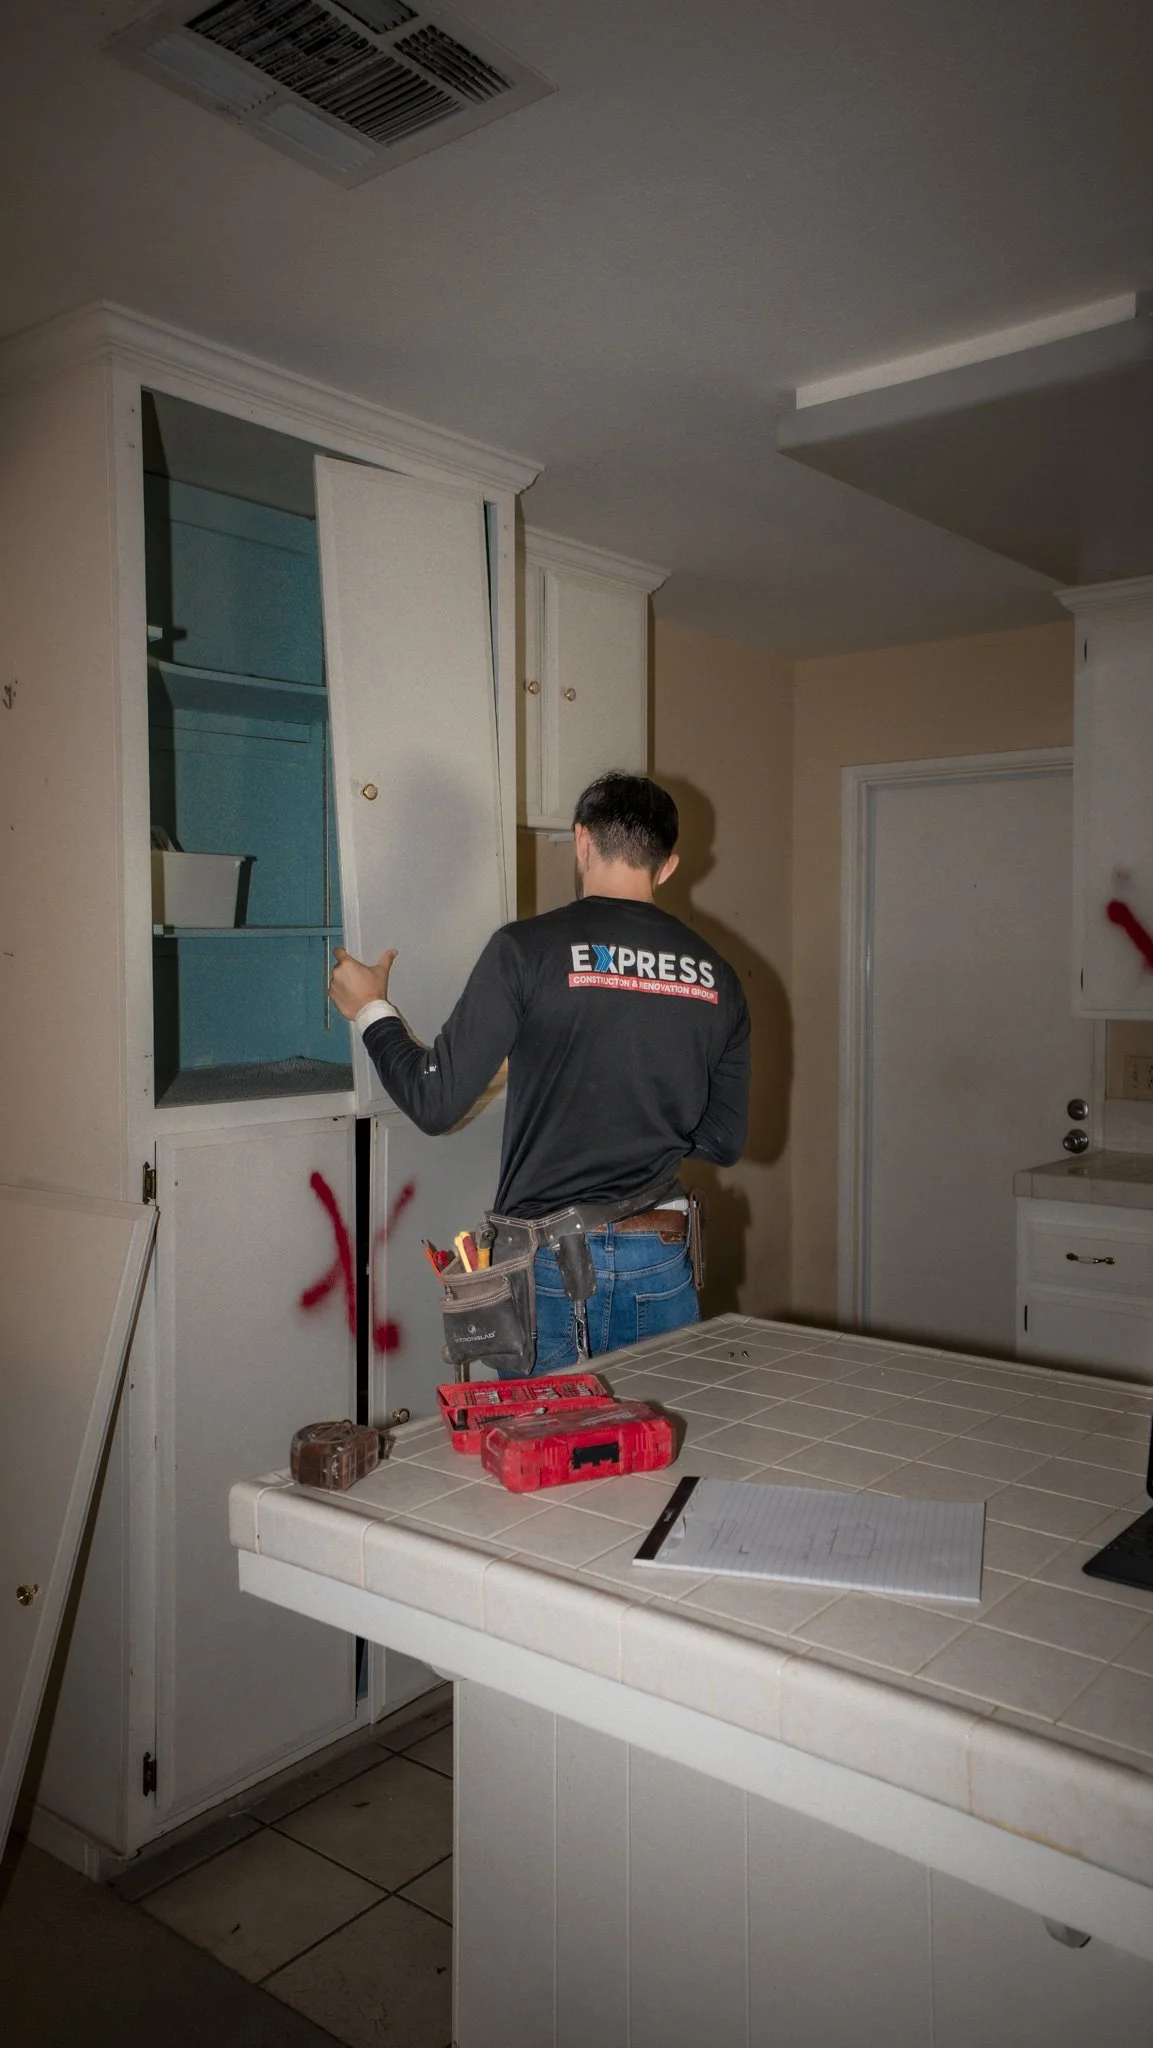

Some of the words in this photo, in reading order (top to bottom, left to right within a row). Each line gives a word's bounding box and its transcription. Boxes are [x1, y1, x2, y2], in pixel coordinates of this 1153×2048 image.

[571, 944, 715, 988] EXPRESS
[573, 976, 630, 987] CONSTRUCTON
[632, 980, 638, 988] &
[639, 981, 689, 995] RENOVATION
[691, 988, 715, 1000] GROUP
